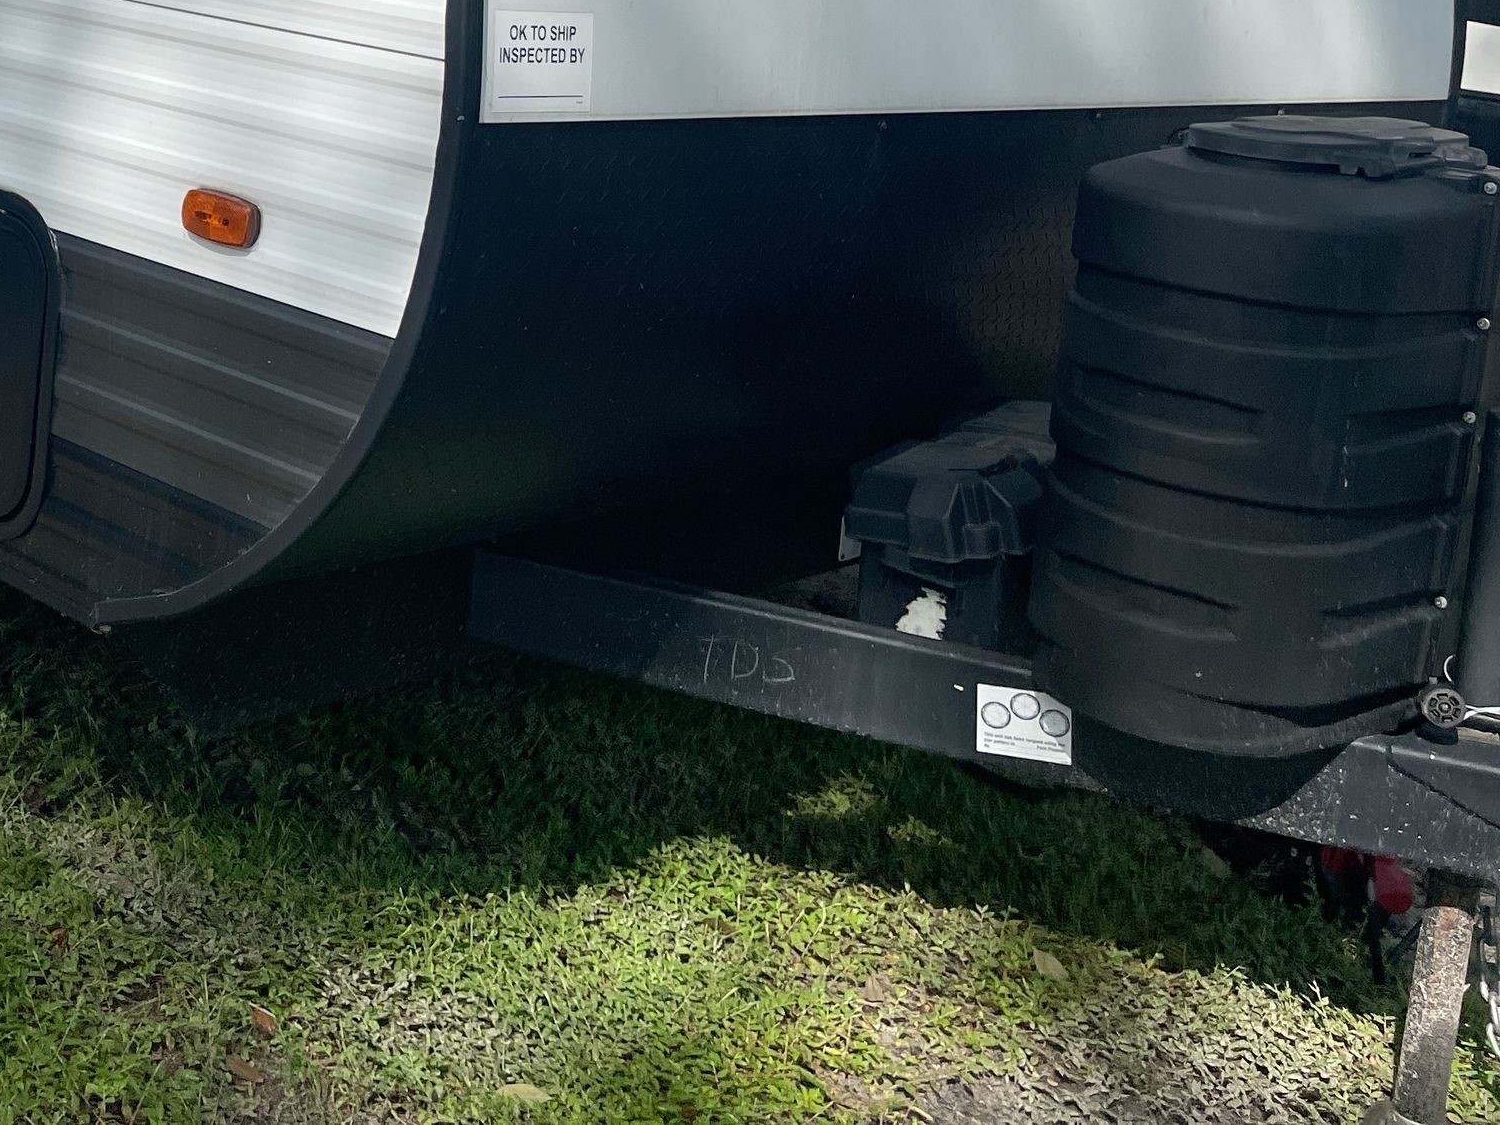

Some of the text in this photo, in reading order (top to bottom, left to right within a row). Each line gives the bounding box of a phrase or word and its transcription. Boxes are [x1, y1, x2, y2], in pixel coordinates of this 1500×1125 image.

[510, 25, 576, 41] OK TO SHIP
[499, 47, 585, 64] INSPECTED BY
